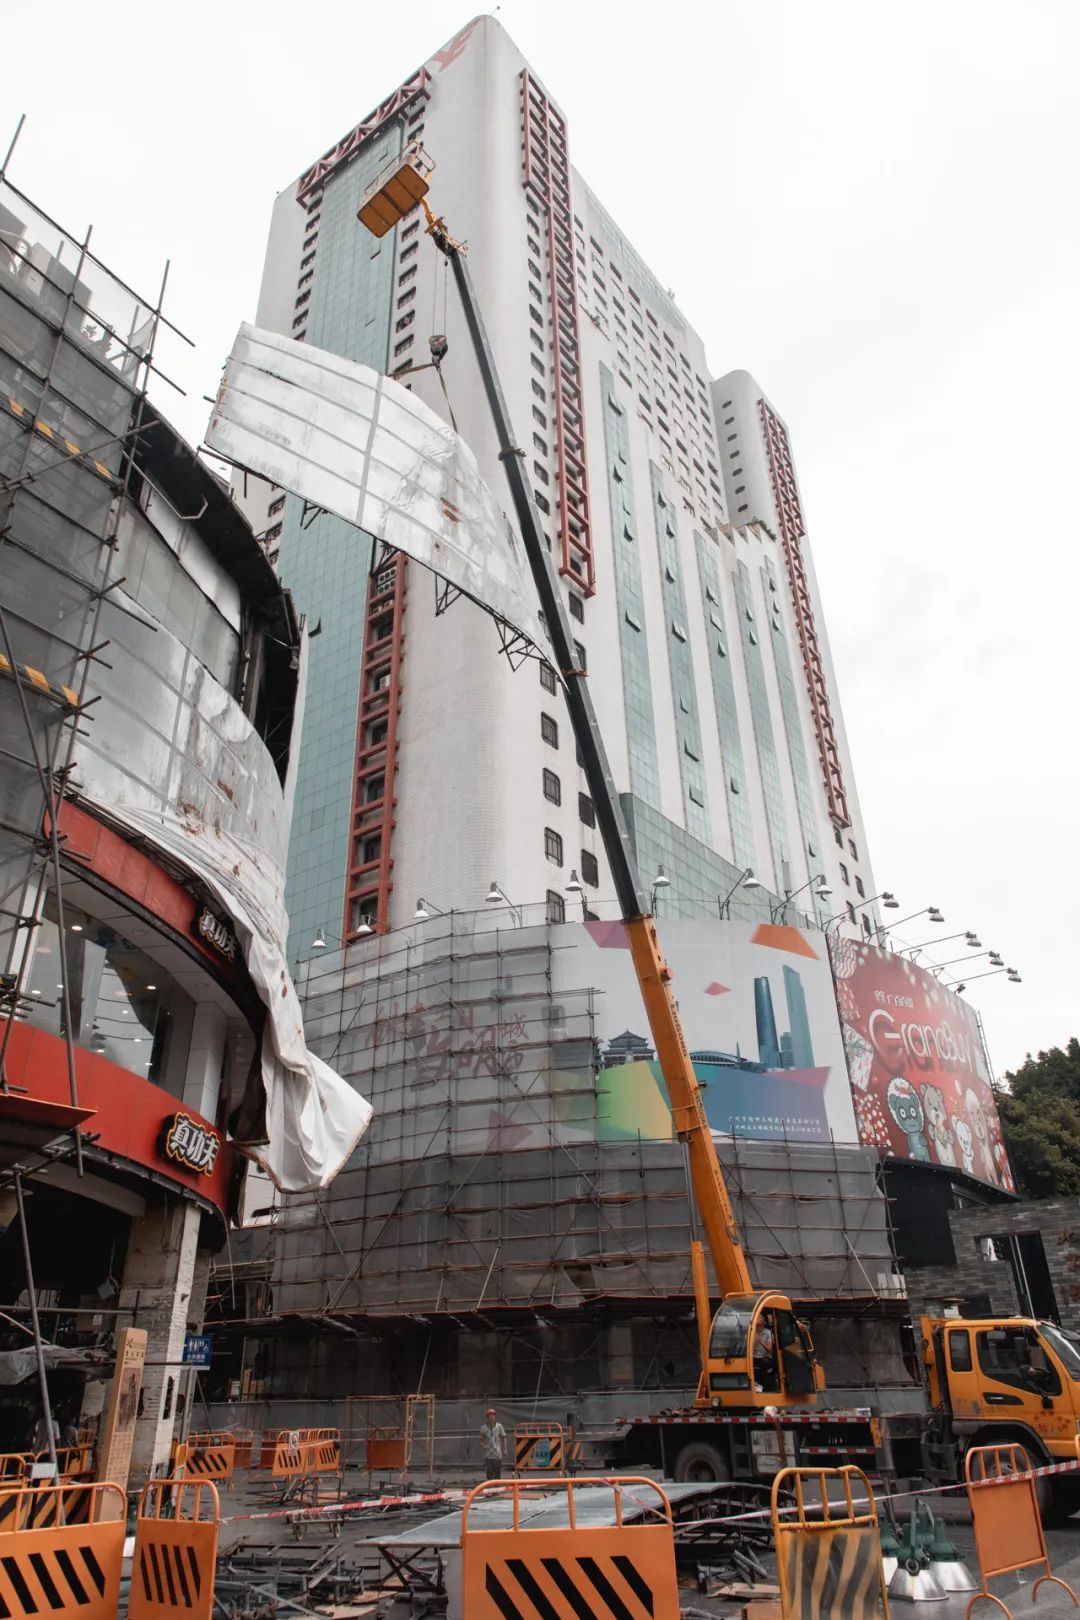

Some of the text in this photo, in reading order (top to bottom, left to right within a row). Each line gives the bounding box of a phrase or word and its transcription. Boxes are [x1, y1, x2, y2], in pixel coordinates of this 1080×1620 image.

[201, 908, 237, 960] 真功夫
[168, 1114, 219, 1173] 真功夫
